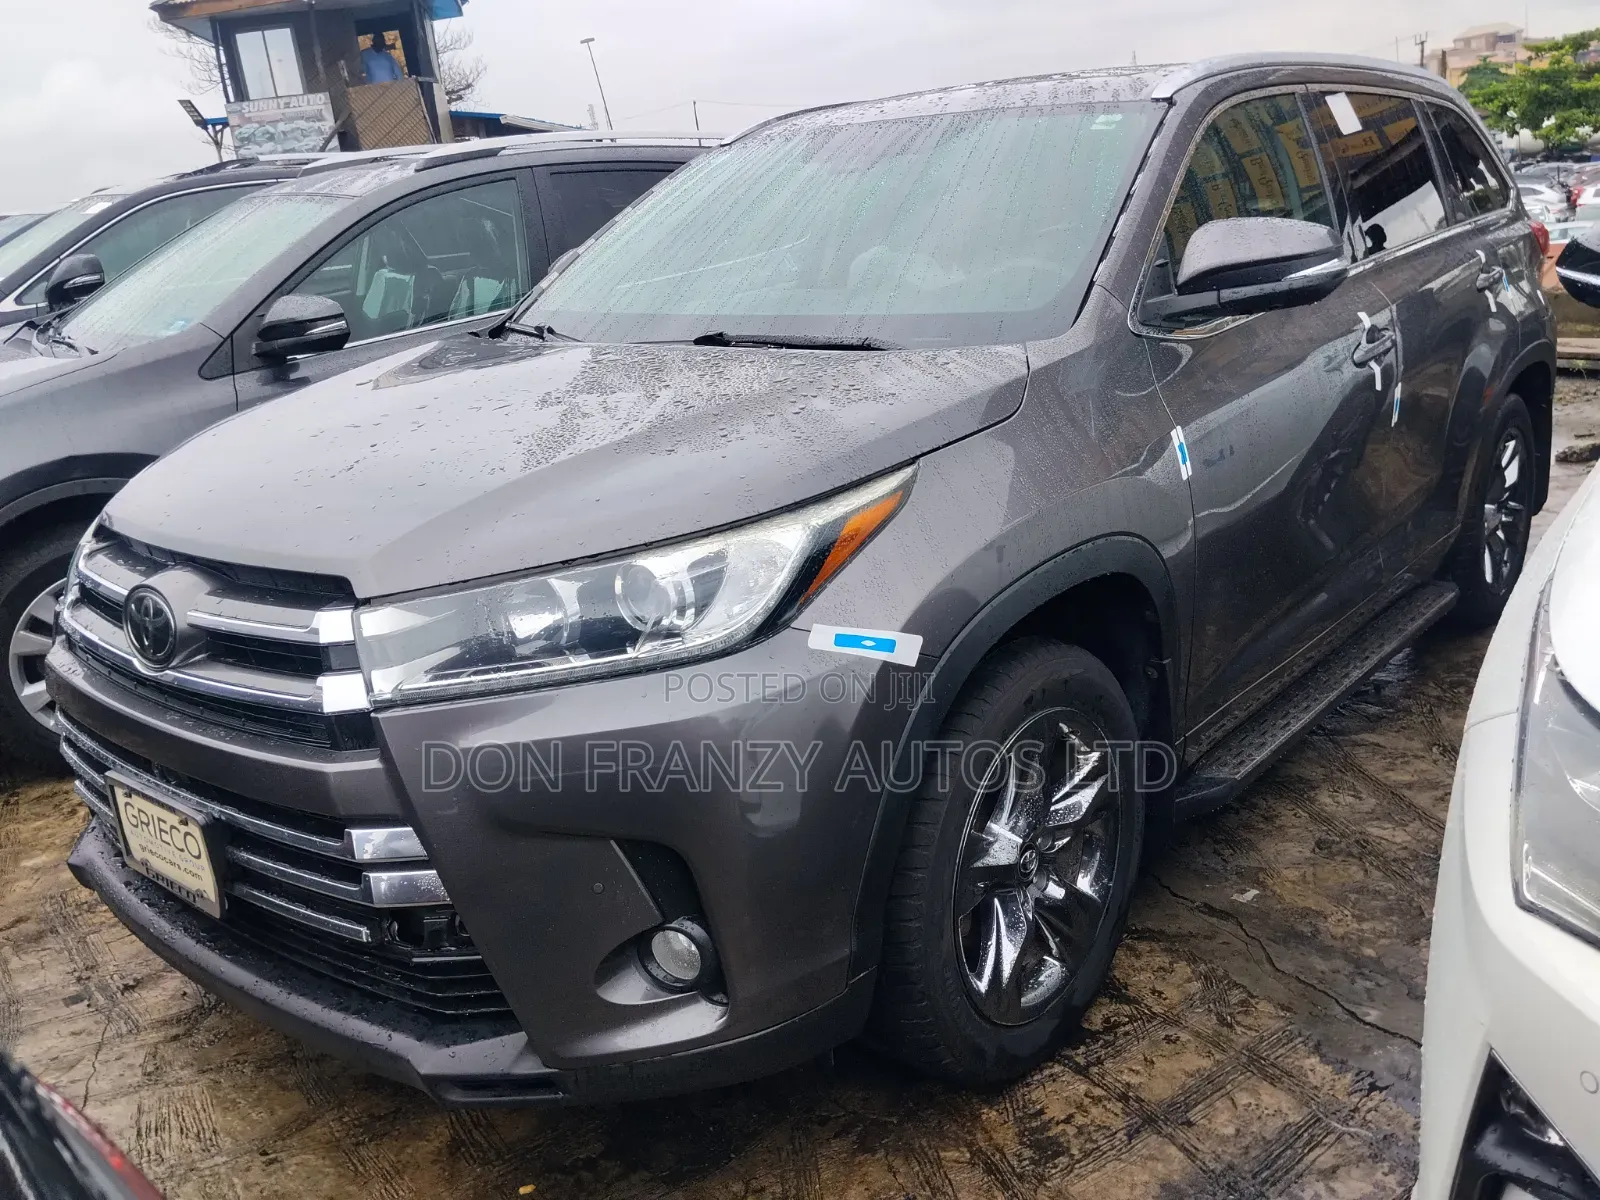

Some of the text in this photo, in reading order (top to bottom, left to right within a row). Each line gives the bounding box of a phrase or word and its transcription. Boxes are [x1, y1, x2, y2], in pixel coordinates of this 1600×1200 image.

[241, 93, 325, 113] SUNNY AUTO
[124, 801, 202, 860] GRIECO
[139, 843, 203, 882] griecocars.com
